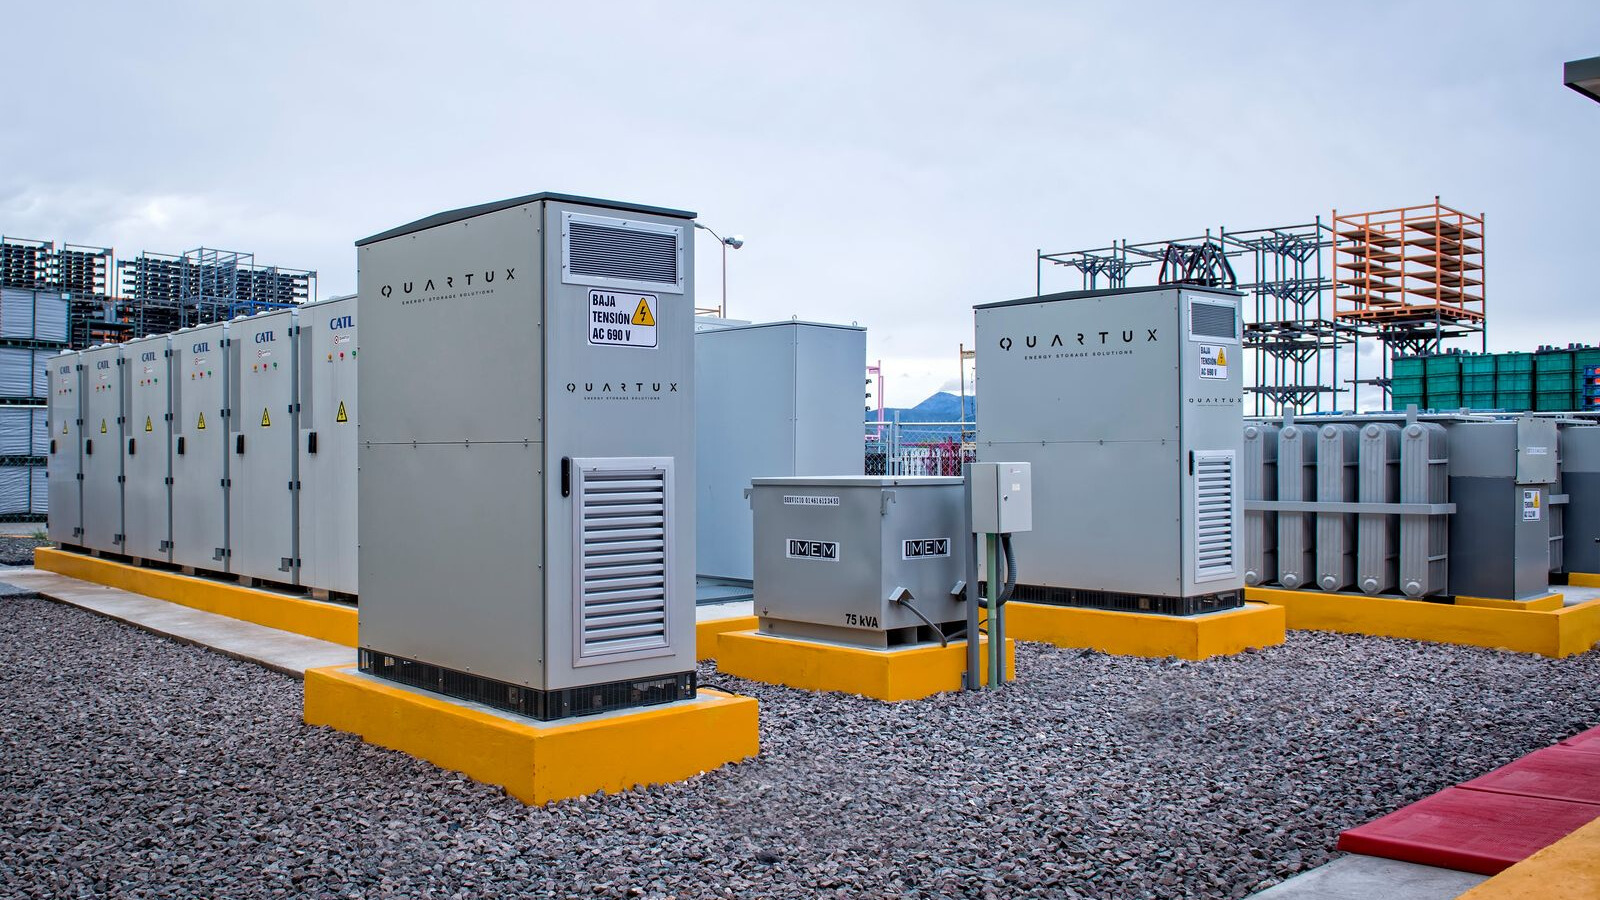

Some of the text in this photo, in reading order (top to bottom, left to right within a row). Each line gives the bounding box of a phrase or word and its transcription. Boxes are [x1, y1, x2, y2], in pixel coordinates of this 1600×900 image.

[381, 268, 515, 298] QUARTUX
[592, 294, 616, 307] BAJA
[330, 315, 355, 330] CATL
[592, 311, 630, 325] TENSIÓN
[255, 331, 276, 344] CATL
[592, 328, 631, 341] AC 690 V
[1000, 329, 1157, 351] QUARTUX
[193, 342, 210, 354] CATL
[142, 352, 157, 362] CATL
[97, 360, 110, 369] CATL
[566, 383, 677, 392] QUARTUX
[790, 540, 836, 558] IMEM
[905, 540, 947, 556] IMEM
[846, 614, 878, 628] 75 kVA
